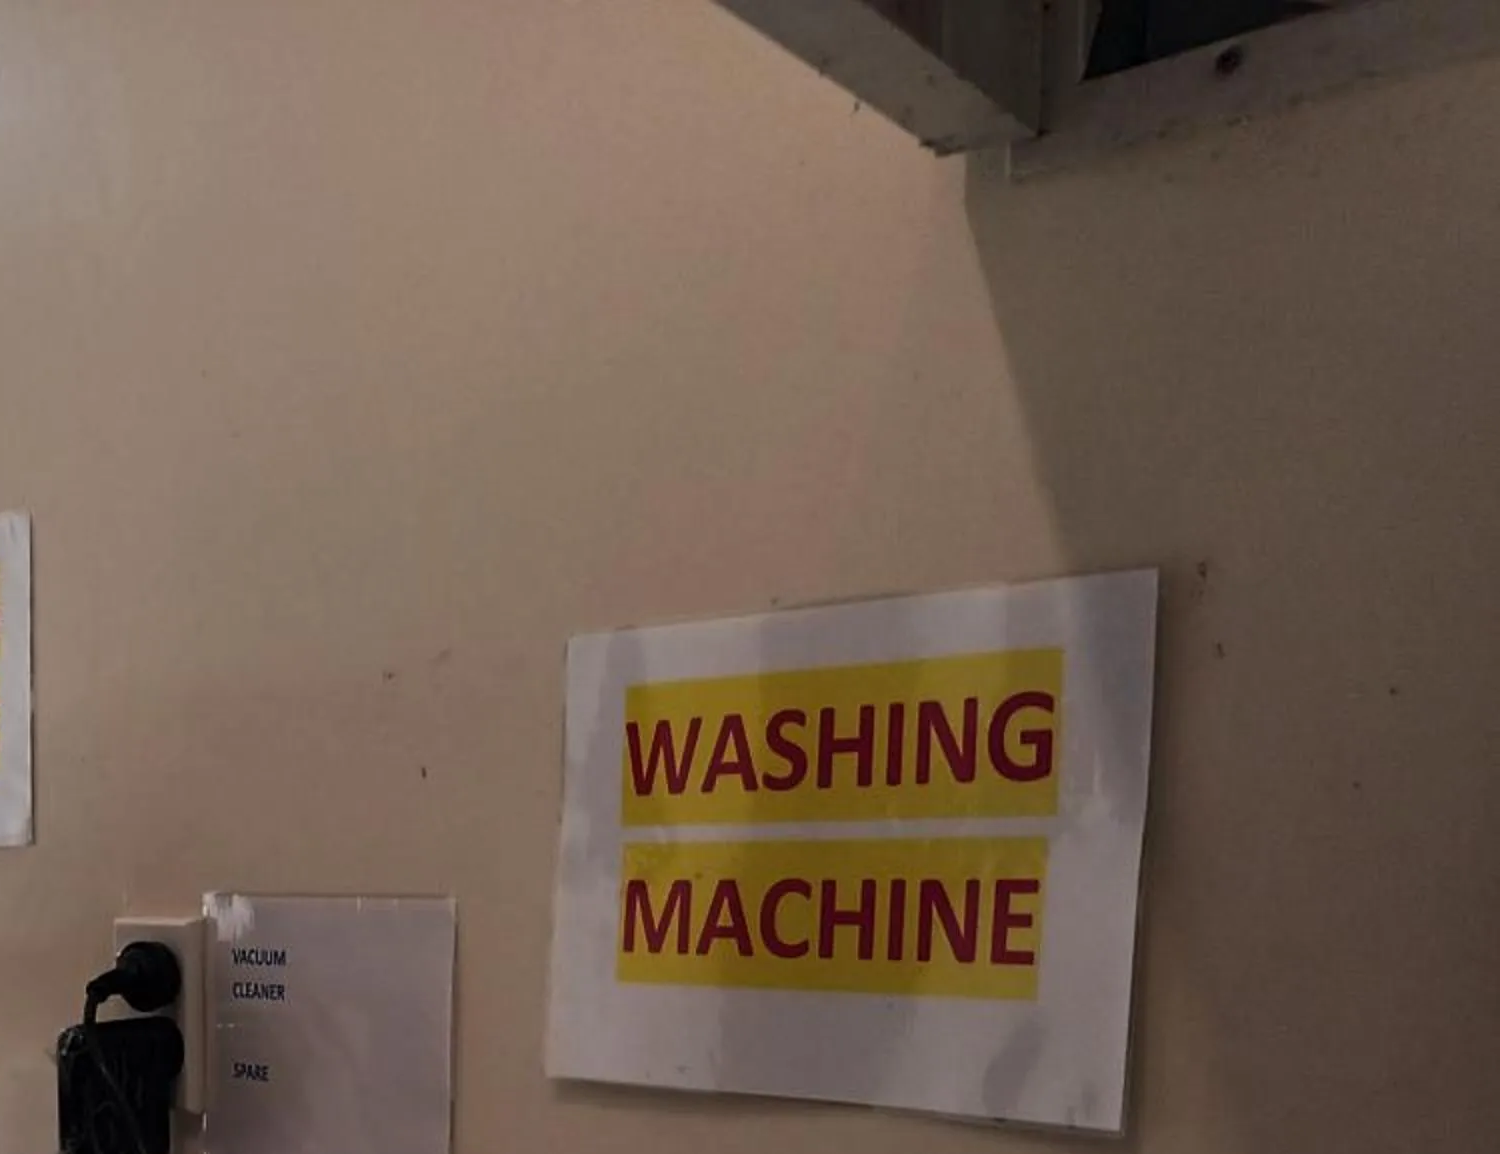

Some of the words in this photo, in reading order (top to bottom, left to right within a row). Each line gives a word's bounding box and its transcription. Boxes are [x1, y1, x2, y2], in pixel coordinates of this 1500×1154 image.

[625, 691, 1055, 797] WASHING
[621, 878, 1041, 966] MACHINE
[232, 948, 287, 967] VACUUM
[232, 982, 285, 1001] CLEANER
[232, 1062, 269, 1082] SPARE
